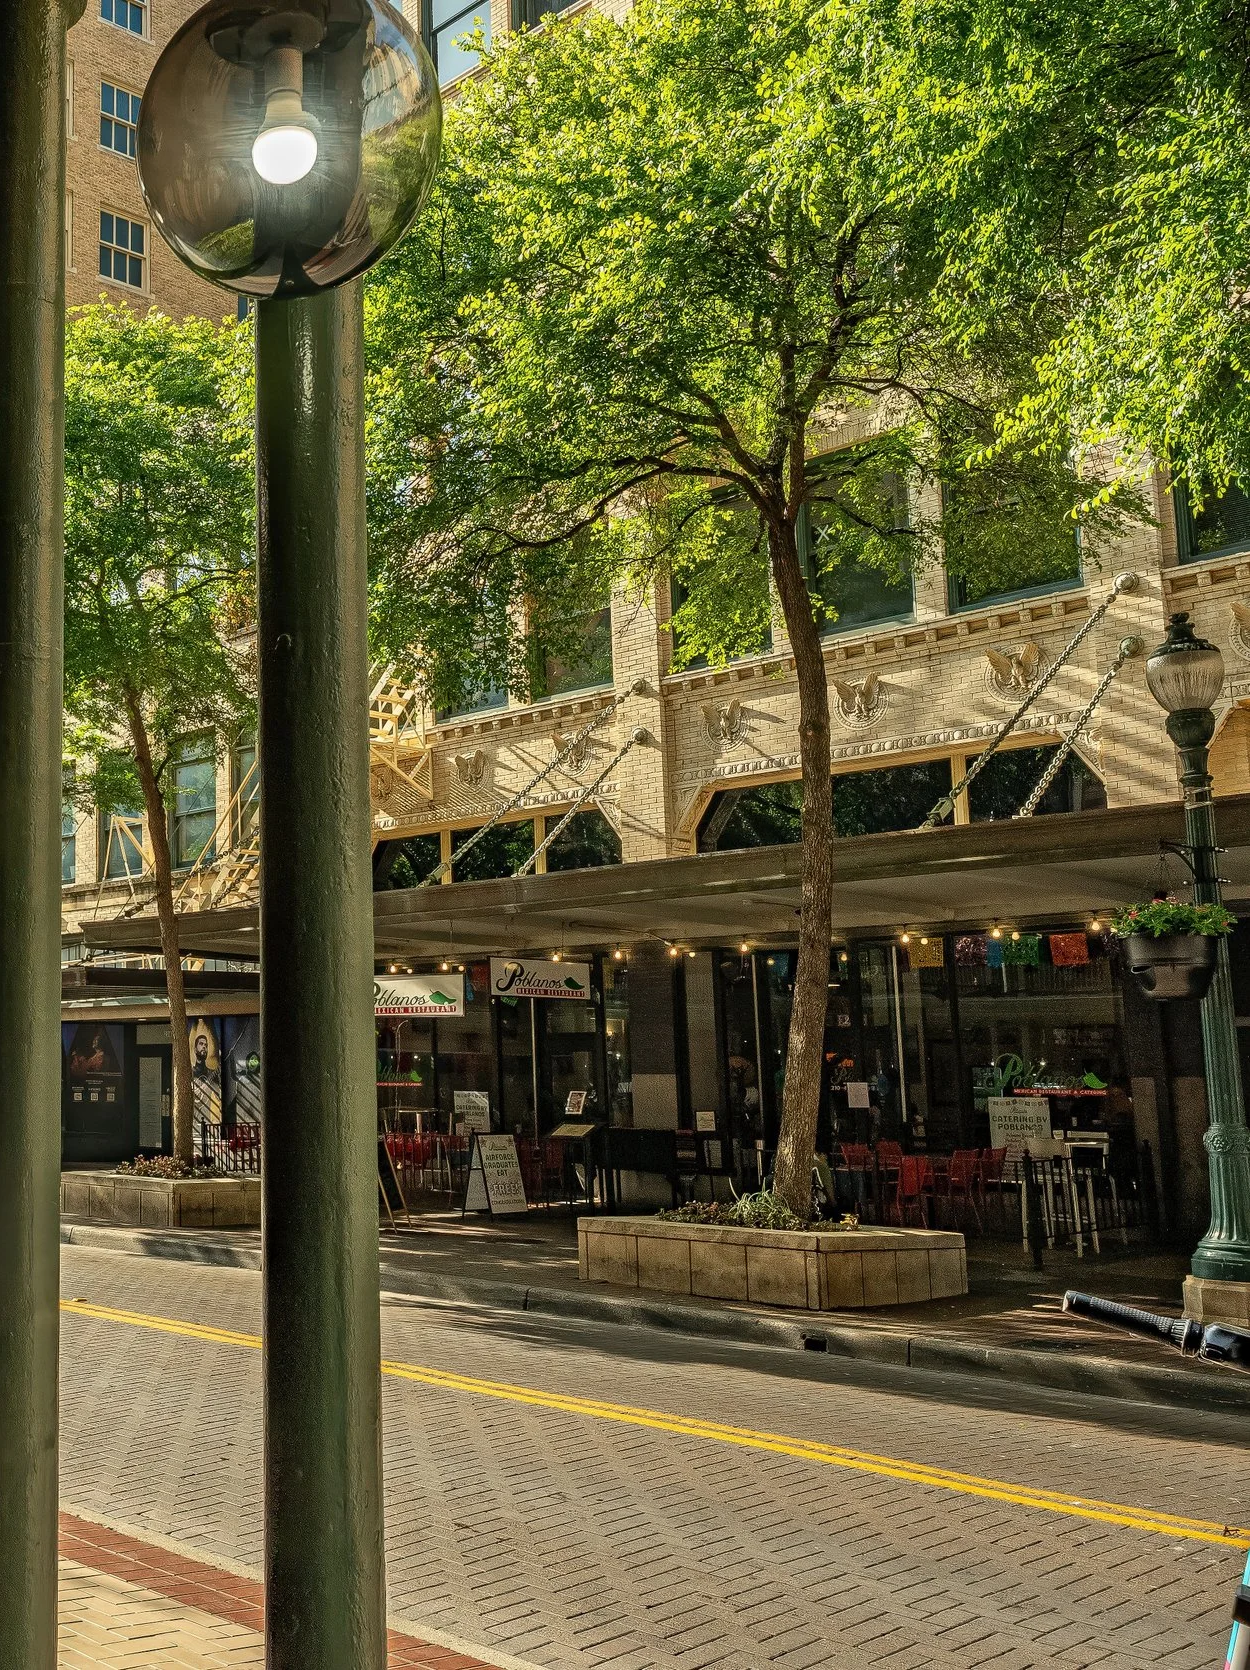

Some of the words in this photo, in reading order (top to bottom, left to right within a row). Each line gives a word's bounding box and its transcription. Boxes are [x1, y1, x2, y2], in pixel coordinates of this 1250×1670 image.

[496, 962, 564, 992] Poblanos
[374, 982, 429, 1007] blanos
[374, 1006, 405, 1014] EXICAN
[992, 1115, 1034, 1123] CATERING
[485, 1153, 514, 1161] AIRFORCE
[483, 1161, 519, 1169] GRADUATES
